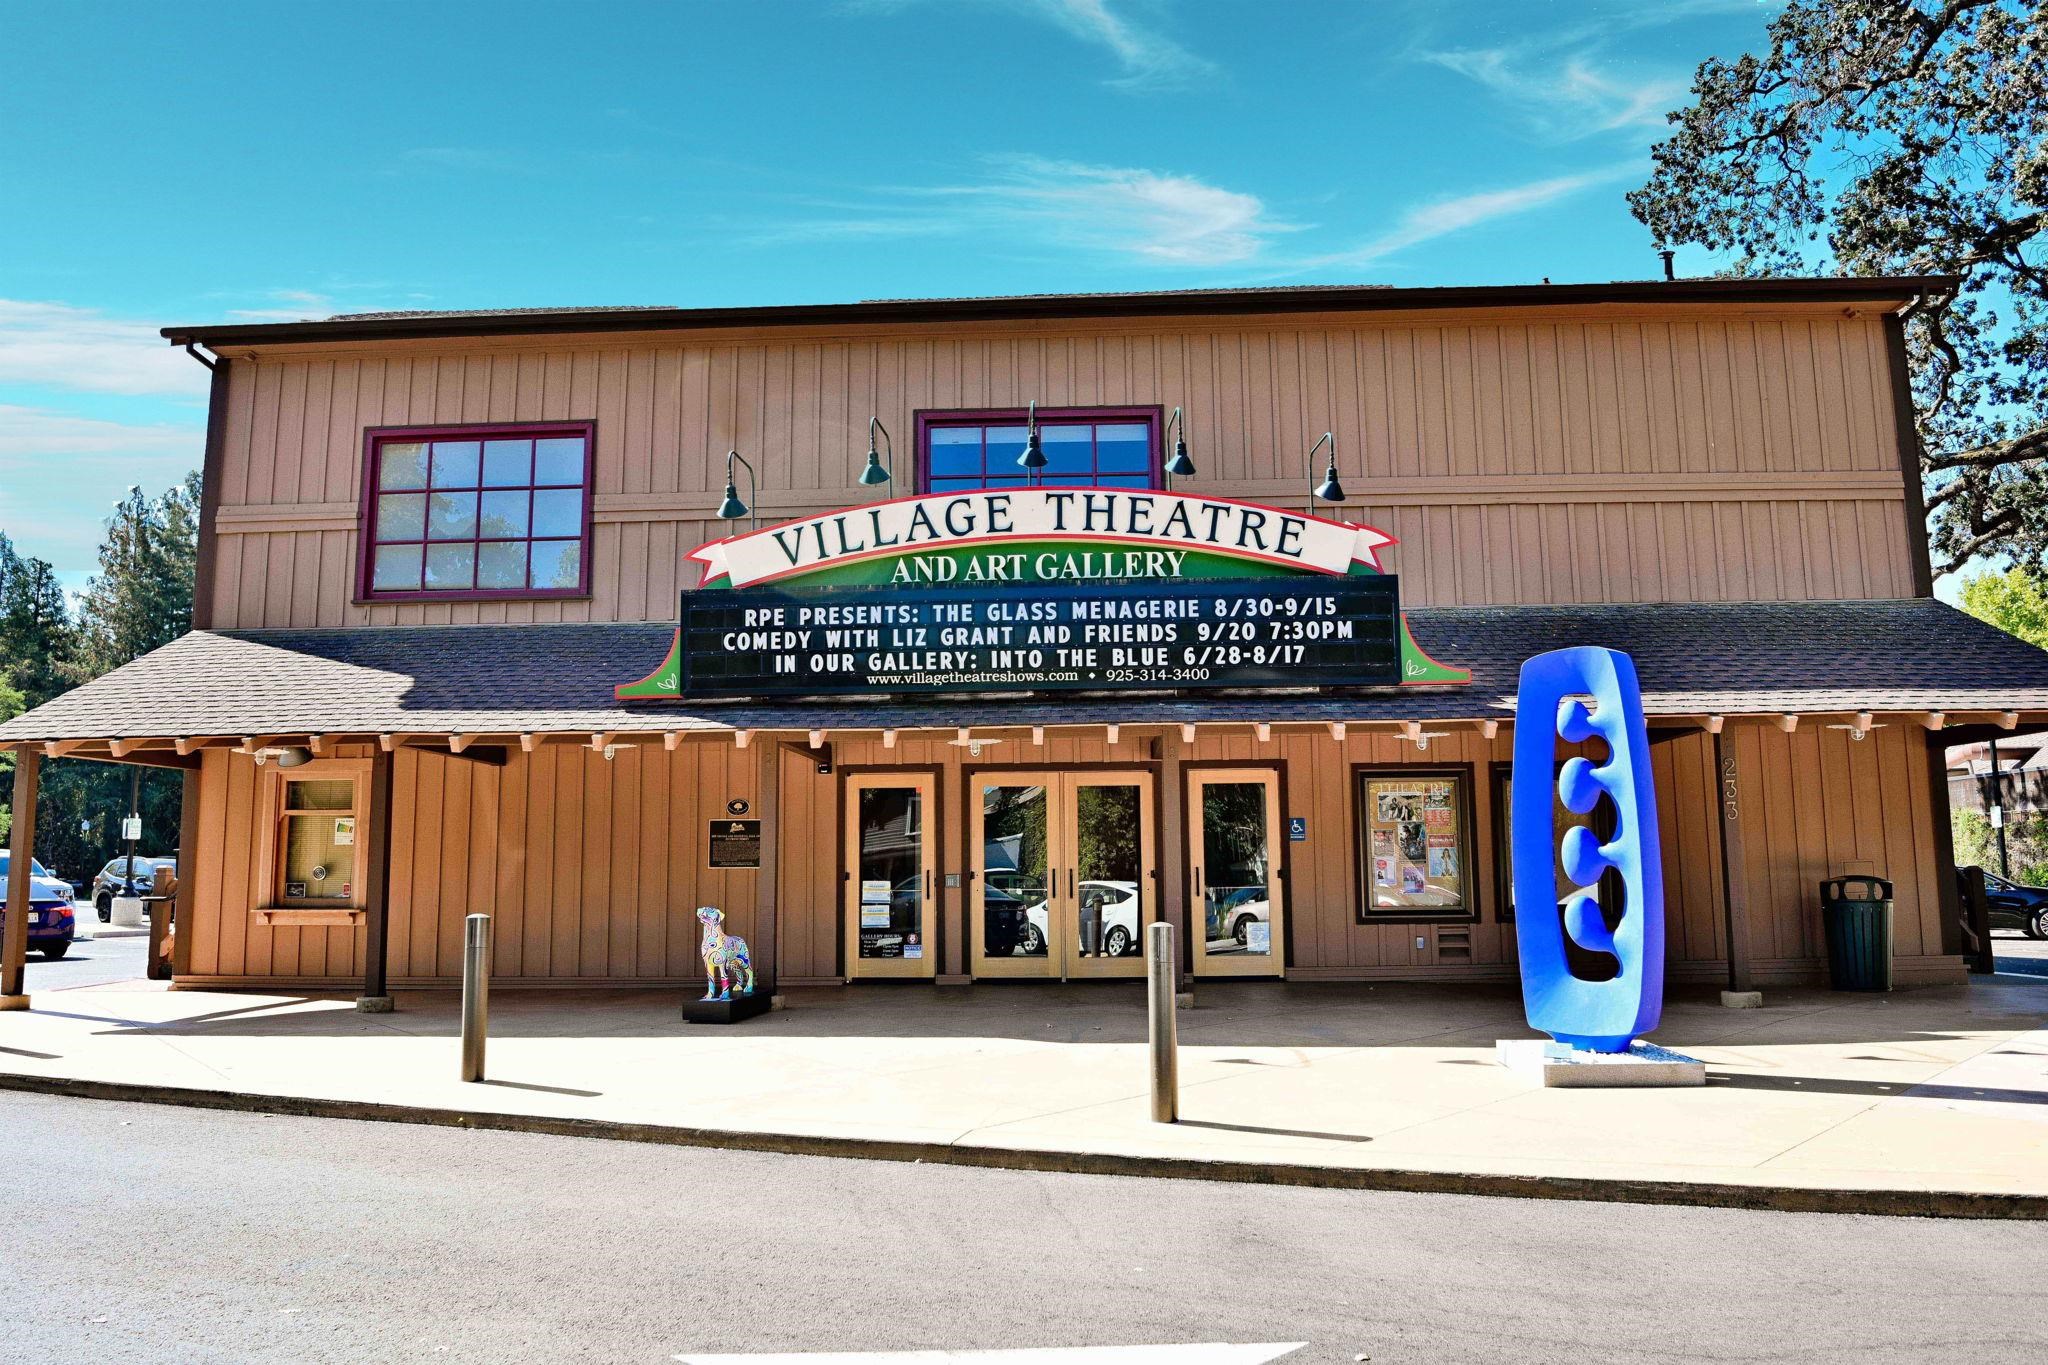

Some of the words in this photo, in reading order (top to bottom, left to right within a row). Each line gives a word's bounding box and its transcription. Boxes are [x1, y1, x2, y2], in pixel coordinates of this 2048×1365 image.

[772, 494, 1014, 567] VILLAGE
[1045, 492, 1306, 558] THEATRE
[891, 555, 958, 583] AND
[964, 554, 1027, 581] ART
[1035, 551, 1187, 579] GALLERY
[744, 608, 785, 627] RPE
[799, 605, 919, 625] PRESENTS:
[933, 603, 973, 622] THE
[987, 602, 1057, 621] GLASS
[1072, 600, 1200, 620] MENAGERIE
[1214, 597, 1337, 617] 8/30-9/15
[723, 630, 812, 651] COMEDY
[826, 628, 879, 648] WITH
[893, 628, 927, 647] LIZ
[940, 626, 1013, 646] GRANT
[1028, 625, 1071, 644] AND
[1085, 623, 1178, 643] FRIENDS
[1197, 622, 1256, 641] 9/20
[1270, 620, 1353, 640] 7:30PM
[775, 654, 796, 673] IN
[810, 653, 854, 673] OUR
[868, 651, 977, 672] GALLERY:
[991, 650, 1043, 669] INTO
[1057, 648, 1097, 668] THE
[1112, 647, 1169, 667] BLUE
[1183, 645, 1305, 665] 6/28-8/17
[867, 669, 1079, 686] www.villagetheatreshows.com
[1106, 667, 1210, 683] 925-314-3400
[1725, 758, 1738, 819] 233
